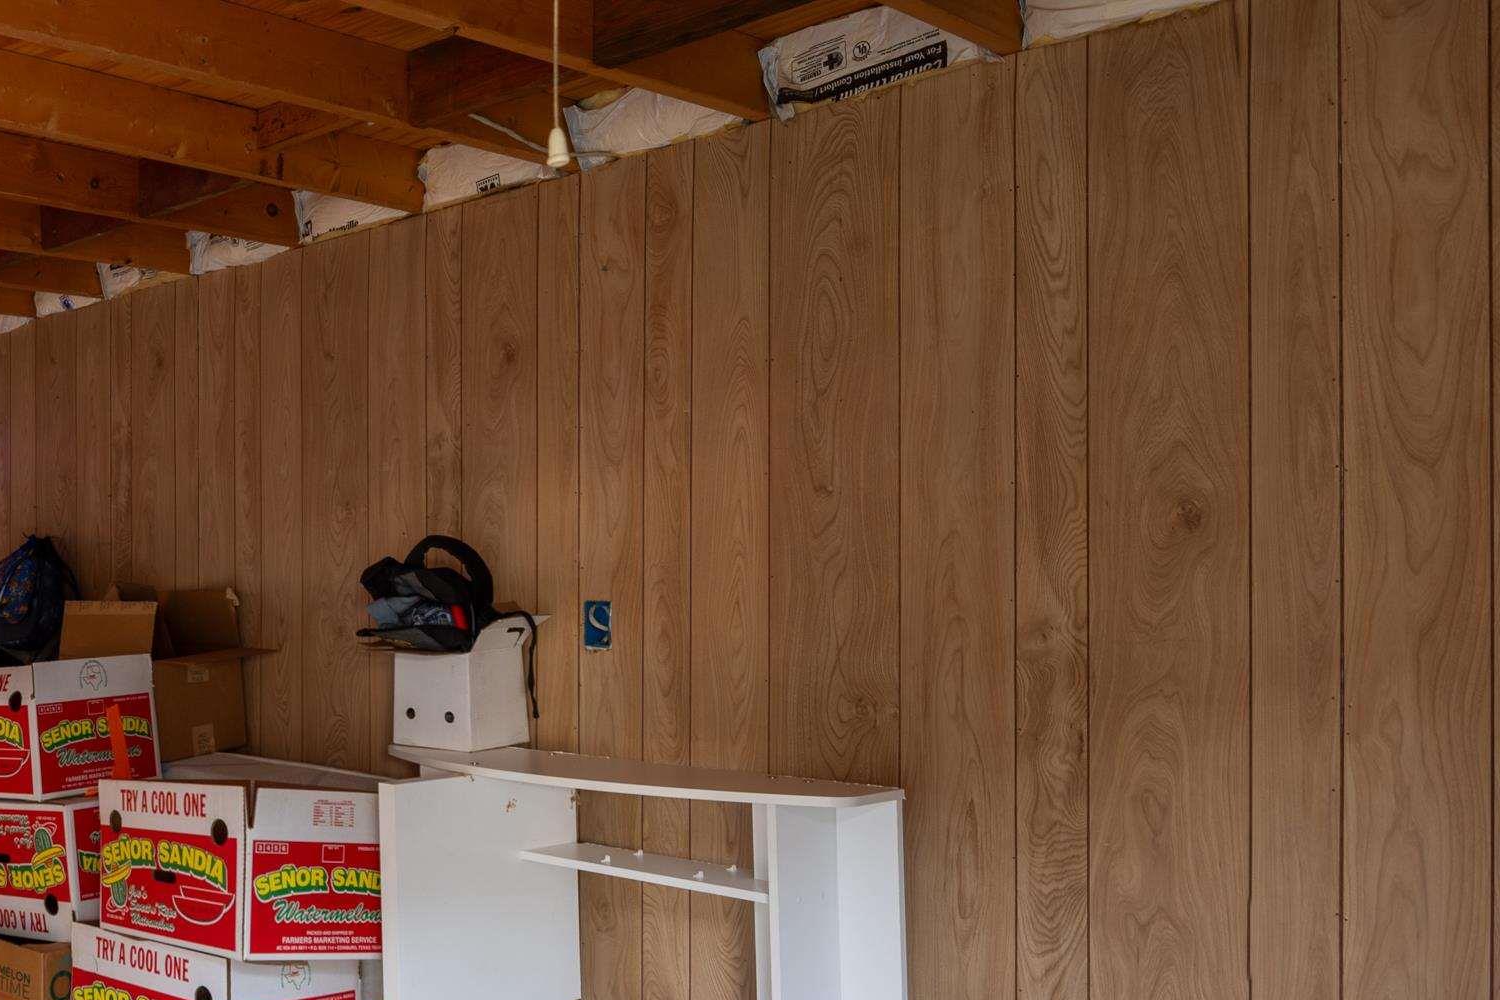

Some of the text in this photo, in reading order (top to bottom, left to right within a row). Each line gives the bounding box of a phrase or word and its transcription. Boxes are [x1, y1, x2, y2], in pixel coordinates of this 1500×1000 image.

[902, 53, 925, 64] Your
[926, 44, 942, 55] For
[854, 59, 901, 80] Installation
[40, 716, 152, 752] SEÑOR SDIA
[120, 789, 206, 818] TRY A COOL ONE
[7, 856, 66, 893] SEÑOR
[102, 834, 157, 873] SEÑOR
[158, 840, 227, 892] SANDIA
[255, 864, 329, 902] SEÑOR
[20, 911, 29, 931] A
[30, 911, 49, 933] TRY
[272, 899, 382, 925] Watermelon
[281, 936, 377, 944] FARMERS MARKETING SERVICE
[96, 936, 189, 982] TRY A COOL ONE
[0, 979, 30, 1000] TIME
